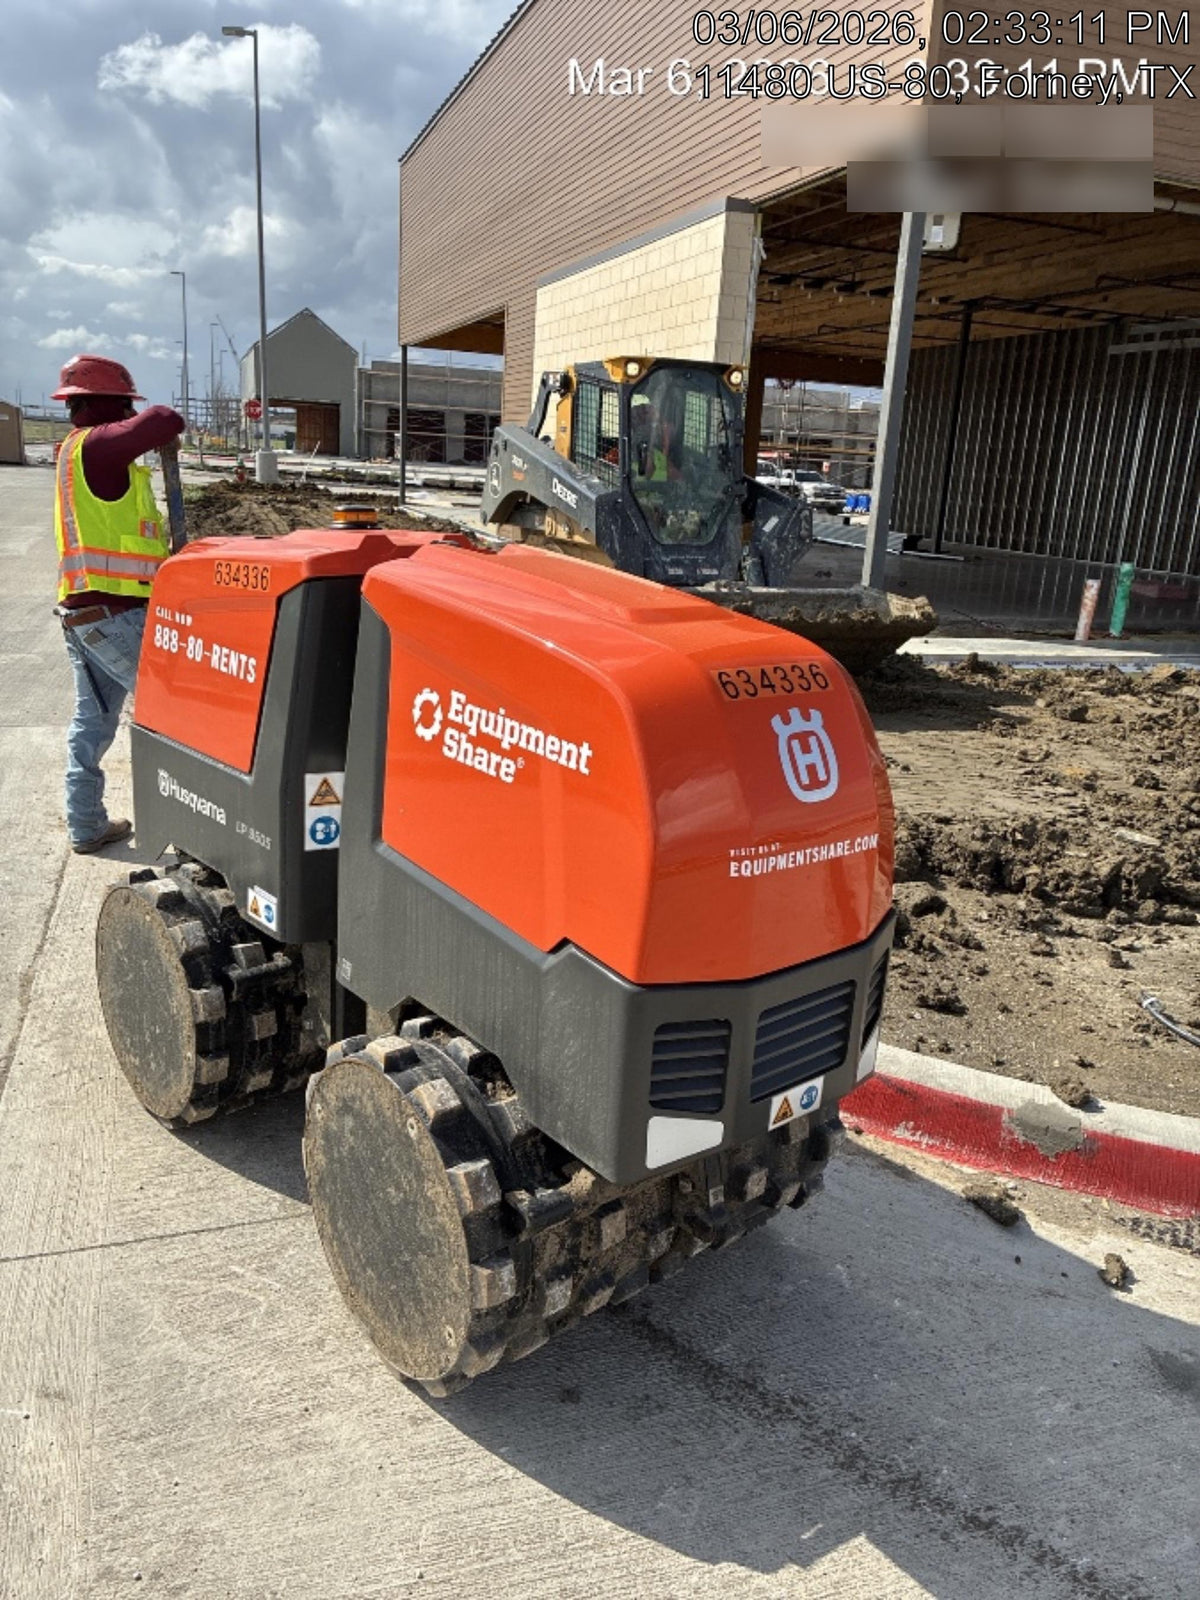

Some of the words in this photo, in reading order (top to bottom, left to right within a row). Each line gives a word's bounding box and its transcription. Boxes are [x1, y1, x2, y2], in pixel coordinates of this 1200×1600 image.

[215, 562, 270, 591] 634336
[155, 605, 173, 621] CALL
[154, 623, 257, 683] 888-80-RENTS
[718, 663, 829, 699] 634336
[448, 689, 593, 776] Equipment
[169, 776, 227, 826] Husqvarna
[729, 833, 880, 877] EQUIPMENTSHARE.COM
[730, 847, 756, 858] VISIT
